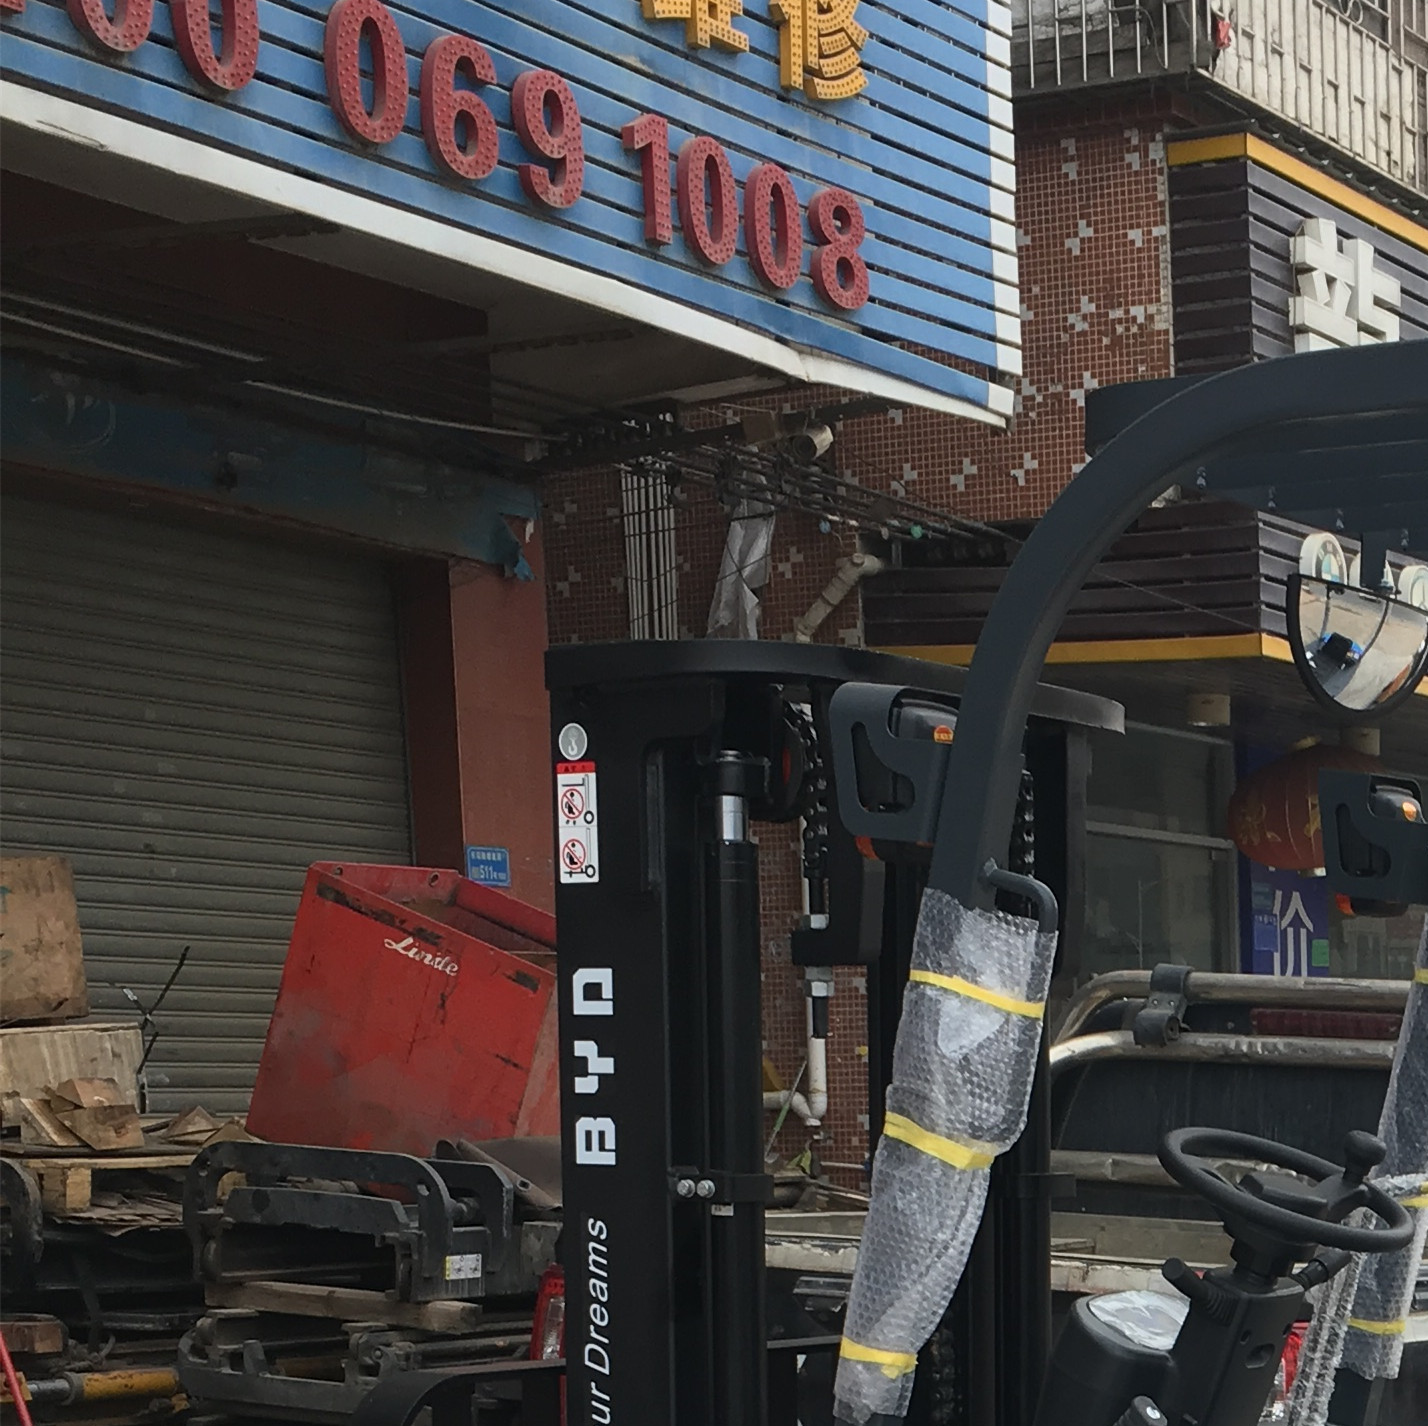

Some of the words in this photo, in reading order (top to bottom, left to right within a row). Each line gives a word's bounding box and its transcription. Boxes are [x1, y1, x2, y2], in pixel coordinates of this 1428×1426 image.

[324, 0, 585, 209] 069
[621, 113, 871, 310] 1008
[1268, 866, 1314, 977] 价
[572, 967, 617, 1166] BYD
[584, 1217, 611, 1376] Dreams
